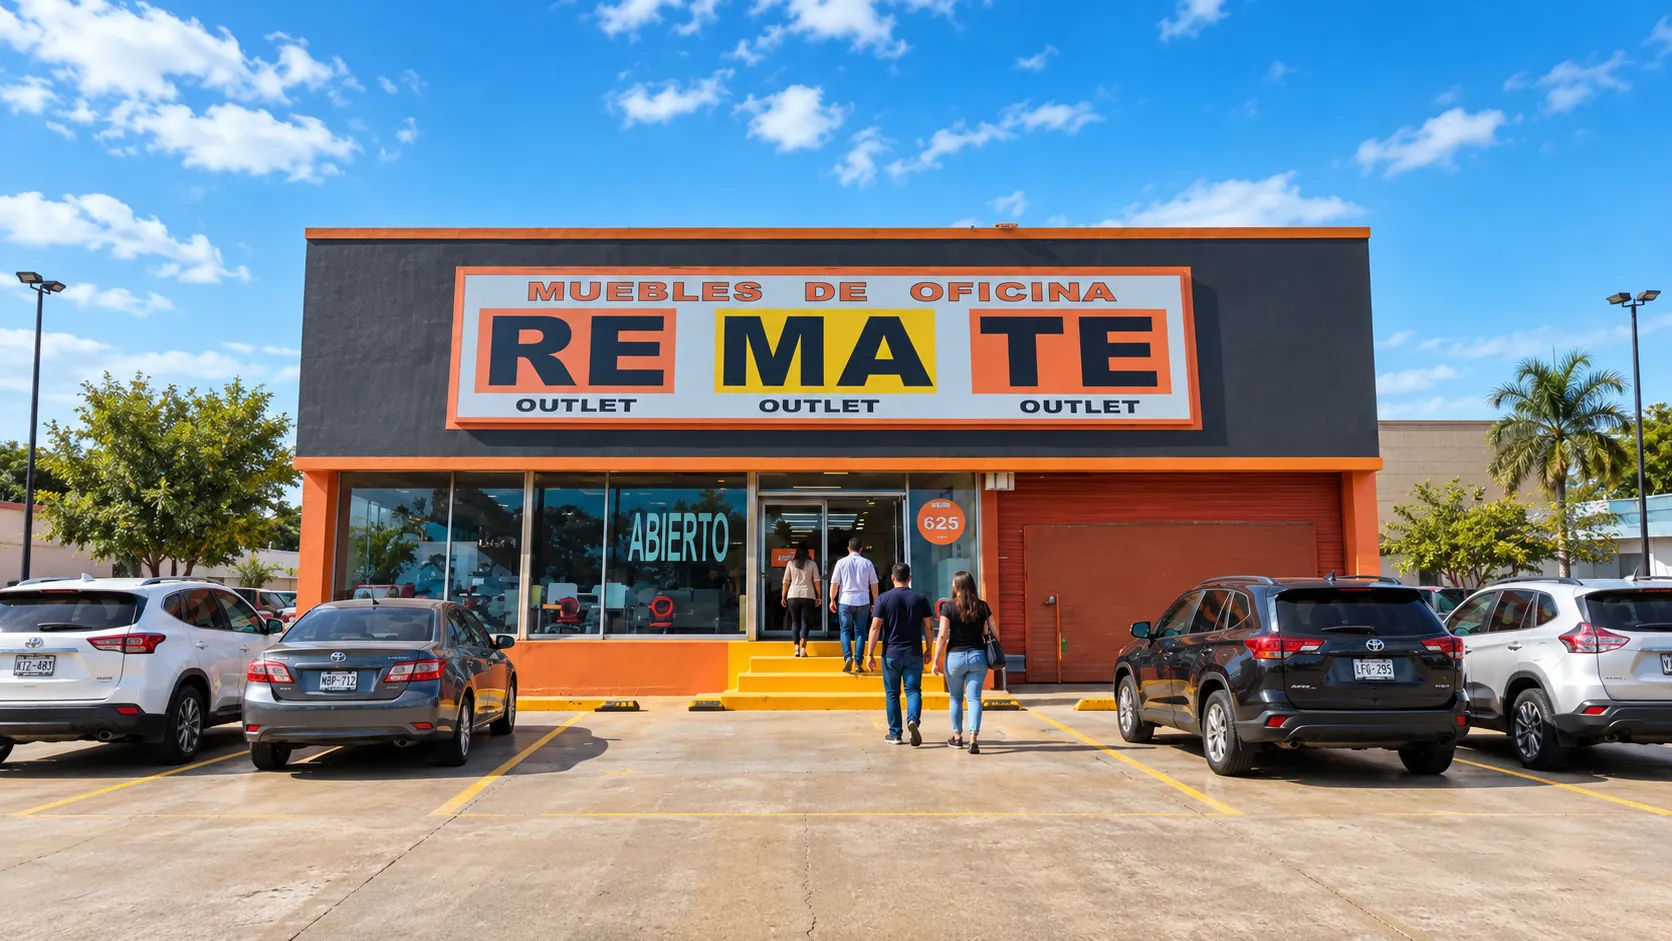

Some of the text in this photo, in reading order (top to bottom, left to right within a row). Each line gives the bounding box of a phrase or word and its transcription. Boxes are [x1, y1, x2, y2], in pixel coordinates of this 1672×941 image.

[527, 281, 1117, 302] MUEBLES DE OFICINA
[488, 315, 1158, 387] RE MA TE
[515, 398, 637, 413] OUTLET
[758, 398, 880, 413] OUTLET
[1019, 399, 1140, 414] OUTLET
[923, 516, 959, 530] 625
[627, 512, 729, 562] ABIERTO
